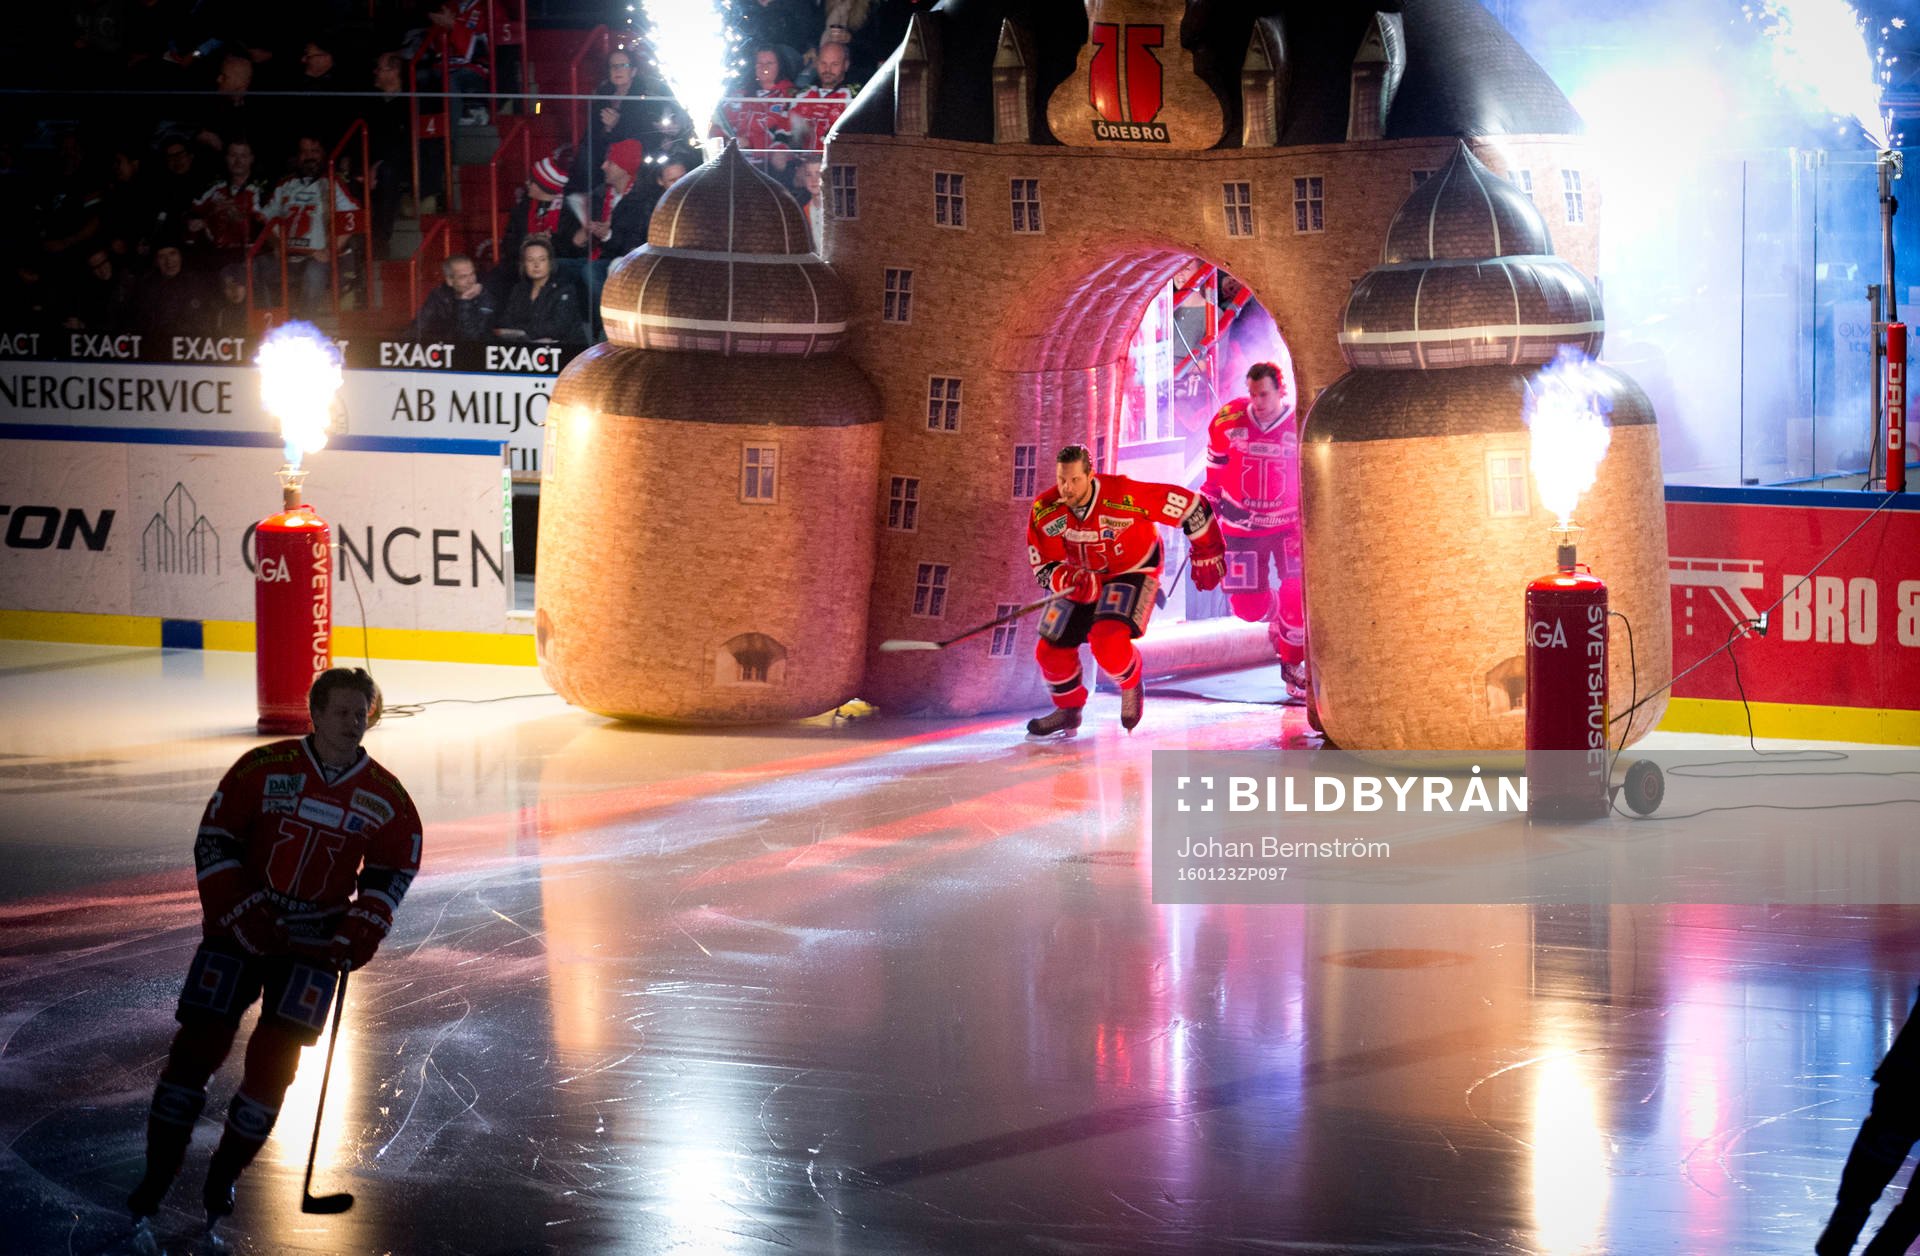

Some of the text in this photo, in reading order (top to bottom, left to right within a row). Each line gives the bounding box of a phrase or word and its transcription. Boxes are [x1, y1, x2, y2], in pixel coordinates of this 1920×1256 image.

[1097, 122, 1165, 141] ÖREBRO
[343, 212, 355, 232] 3
[70, 333, 143, 360] EXACT
[172, 335, 246, 362] EXACT
[379, 341, 456, 369] EXACT
[485, 345, 562, 372] EXACT
[391, 382, 552, 433] AB MILJÖ
[1161, 491, 1188, 519] 88
[0, 504, 116, 552] ON
[1113, 542, 1124, 557] C
[1782, 573, 1878, 646] BRO
[1526, 617, 1568, 649] AGA
[1587, 605, 1605, 782] SVETSHUSET
